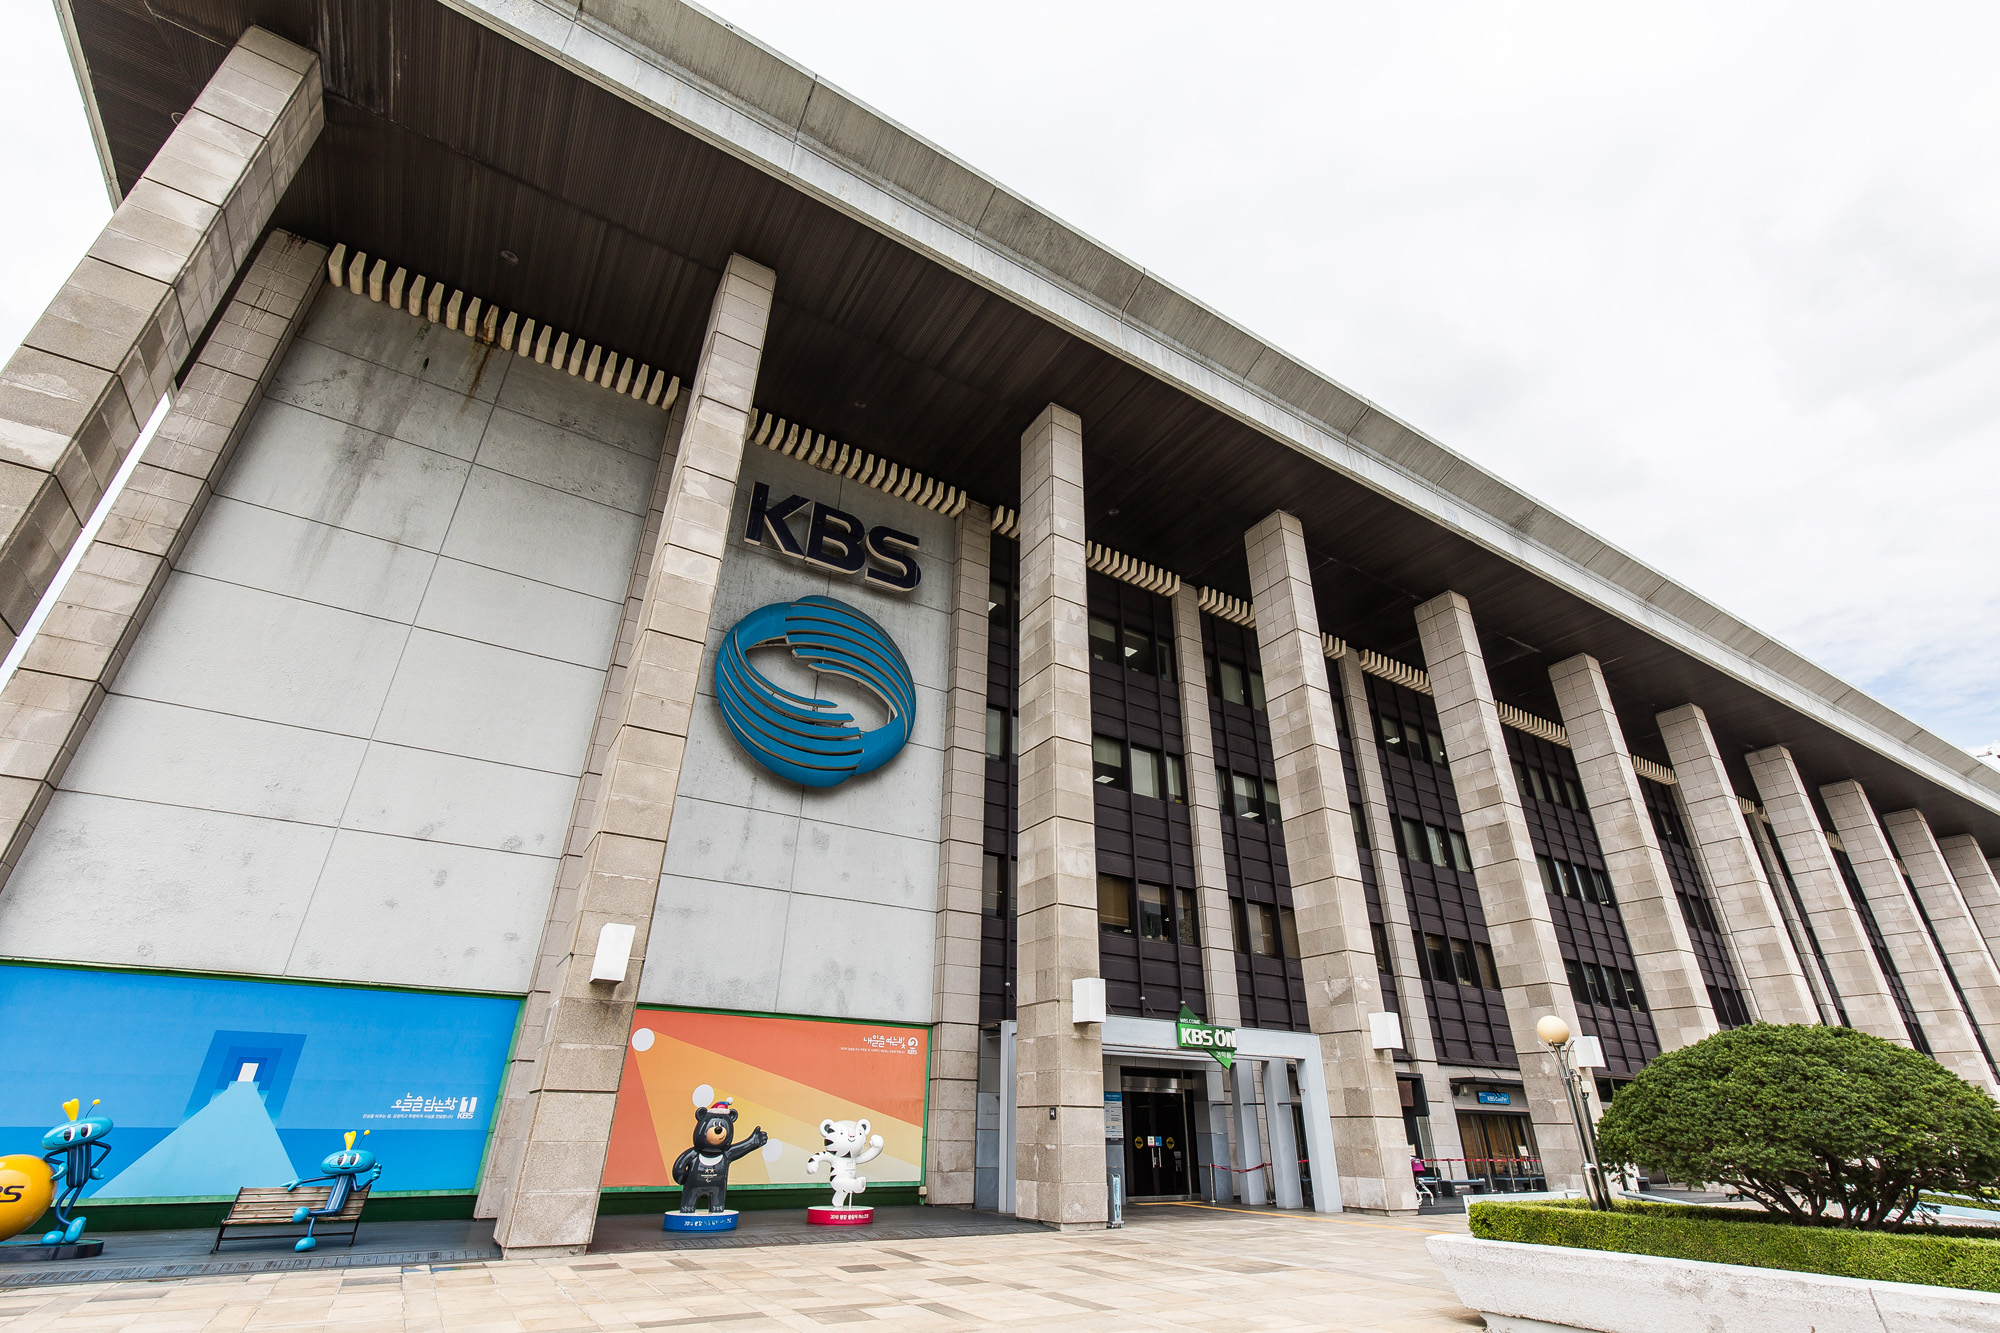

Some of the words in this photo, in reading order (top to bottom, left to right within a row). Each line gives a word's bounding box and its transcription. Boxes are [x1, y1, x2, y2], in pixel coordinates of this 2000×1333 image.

[743, 481, 922, 592] KBS
[1181, 1027, 1214, 1046] KBS
[391, 1092, 424, 1112] 오늘을
[0, 1185, 25, 1203] S
